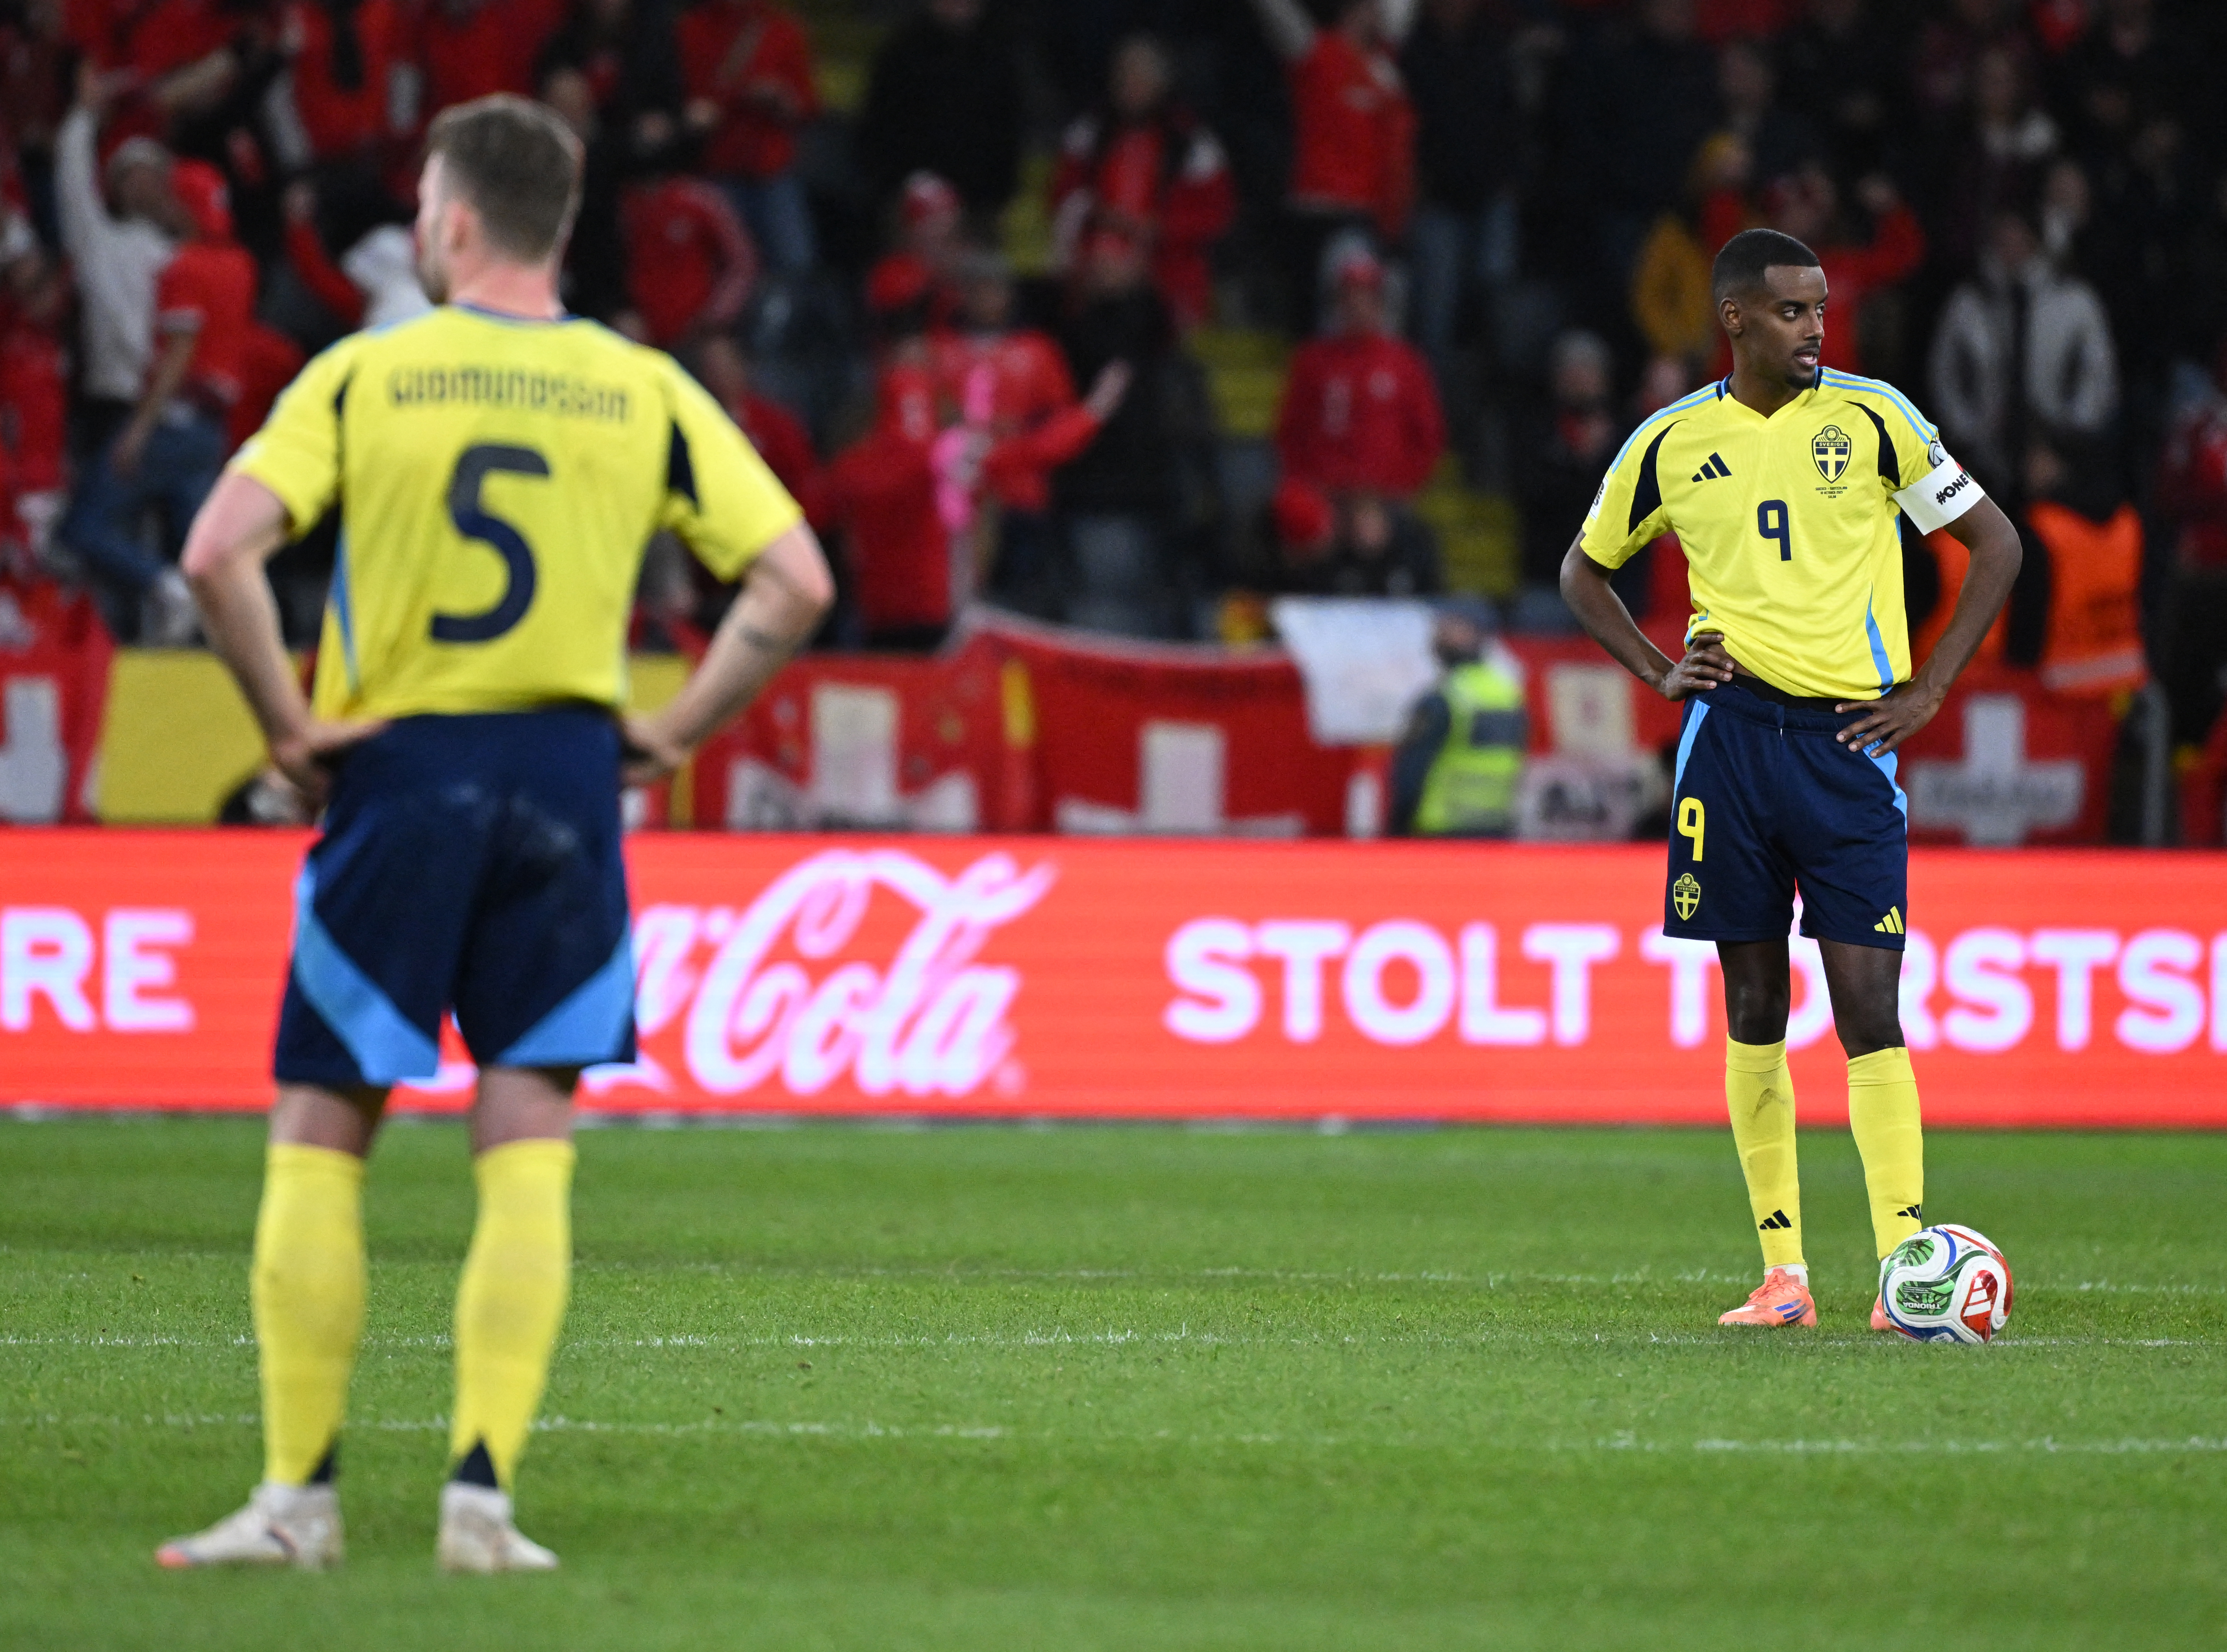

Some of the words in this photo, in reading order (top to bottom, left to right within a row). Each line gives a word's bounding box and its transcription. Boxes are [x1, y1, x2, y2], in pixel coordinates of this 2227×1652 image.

[431, 445, 550, 643] 5
[1757, 499, 1792, 561] 9
[1677, 797, 1705, 862] 9
[1163, 916, 1620, 1048] STOLT
[1903, 1302, 1942, 1310] TRIONDA
